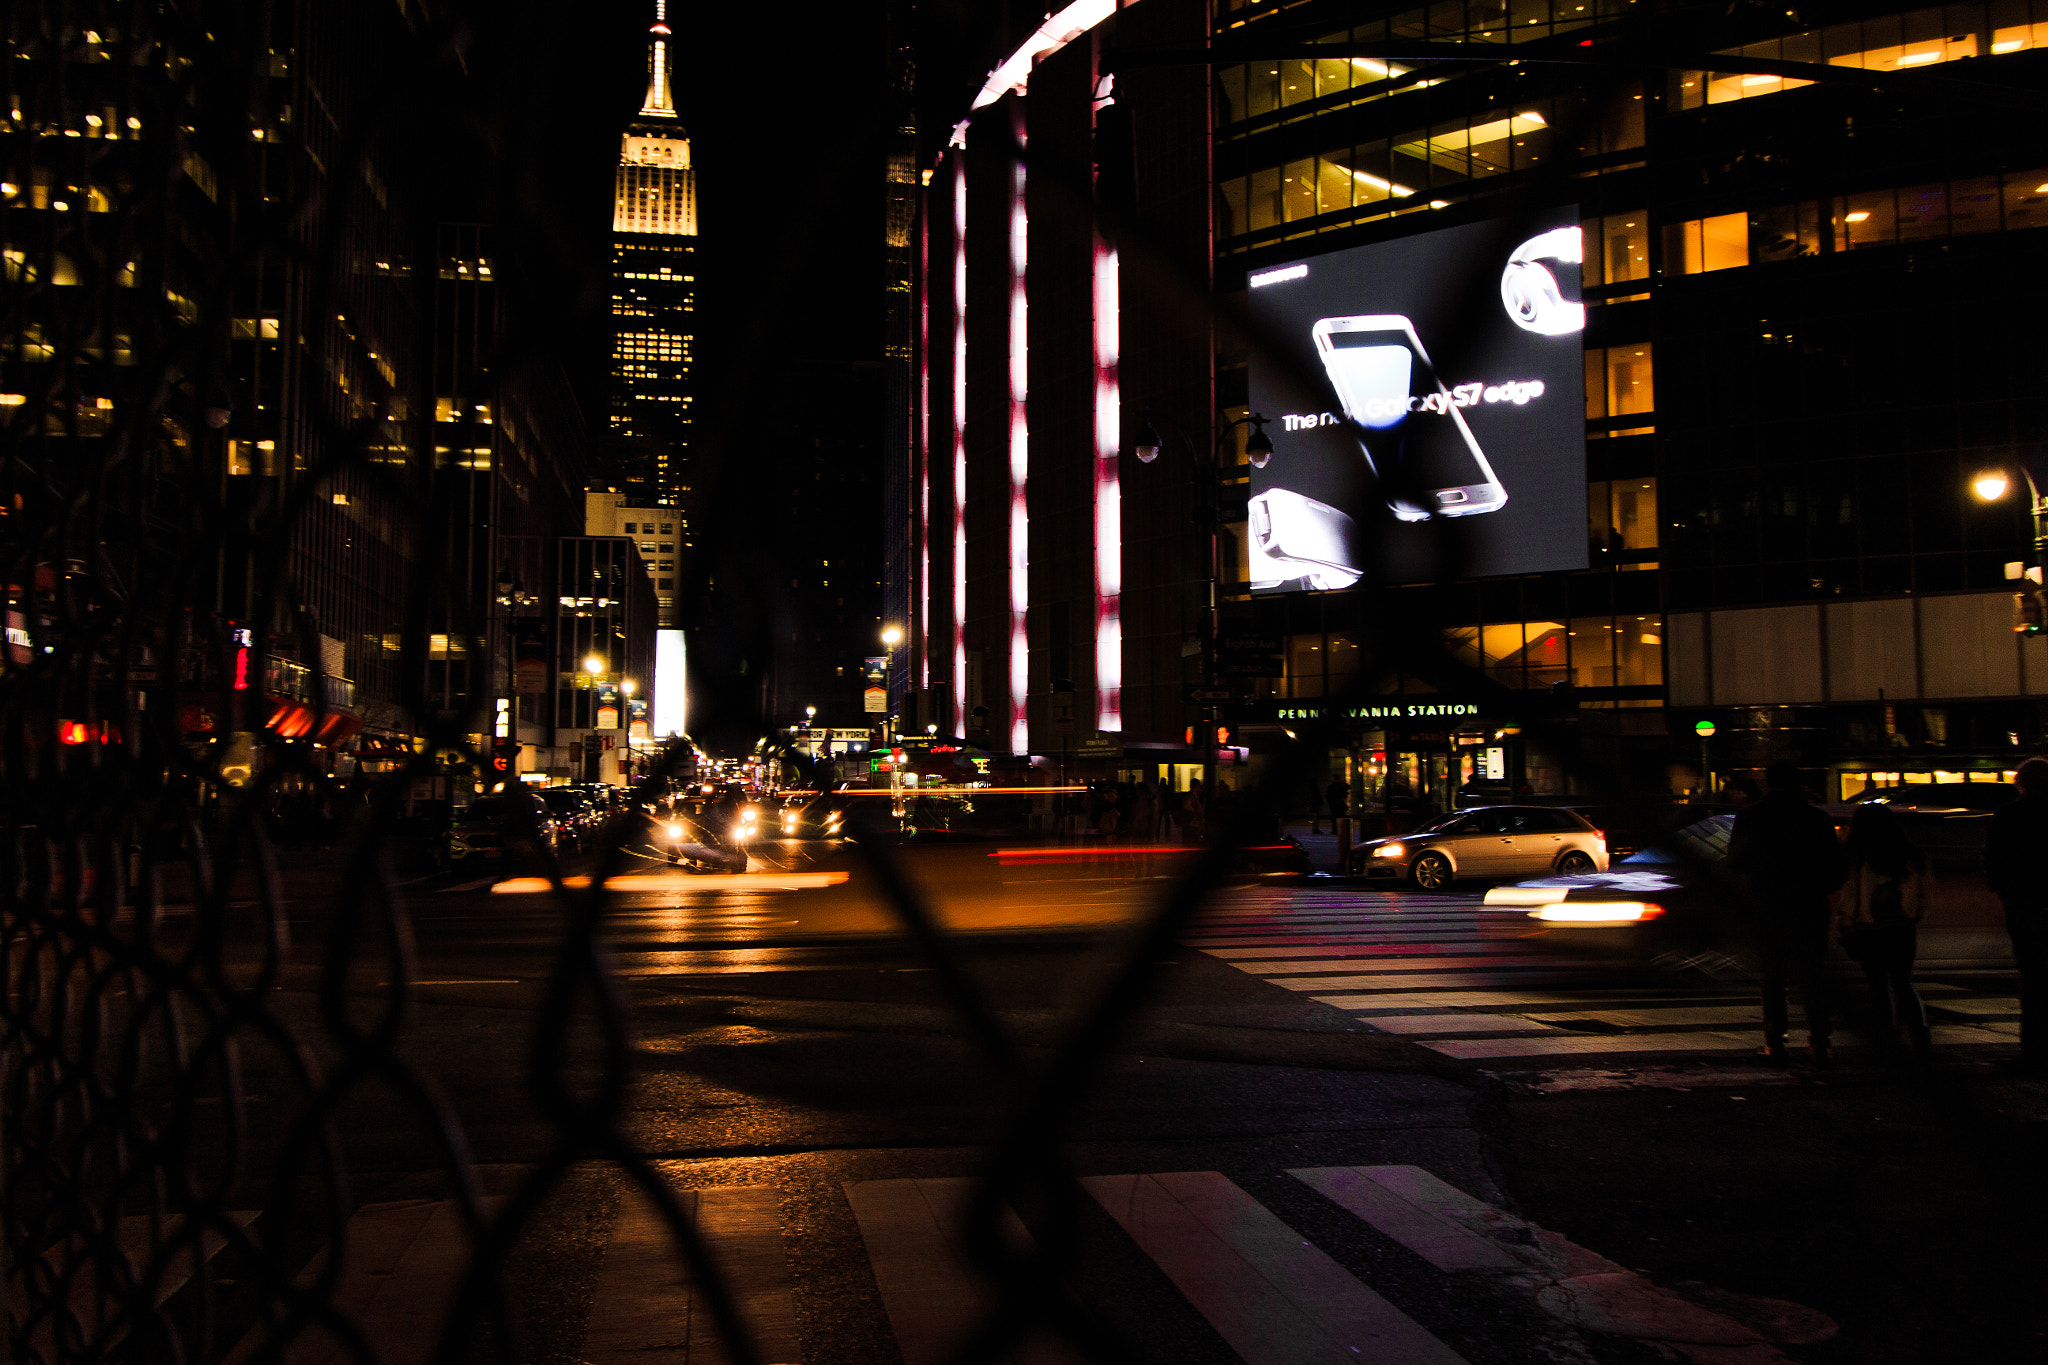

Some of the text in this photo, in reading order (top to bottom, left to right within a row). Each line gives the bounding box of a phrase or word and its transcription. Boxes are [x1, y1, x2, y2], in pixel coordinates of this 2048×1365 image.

[1282, 413, 1317, 432] The
[1453, 382, 1484, 407] S7
[1483, 380, 1545, 406] edge
[1278, 704, 1478, 719] PENNVANIA STATION
